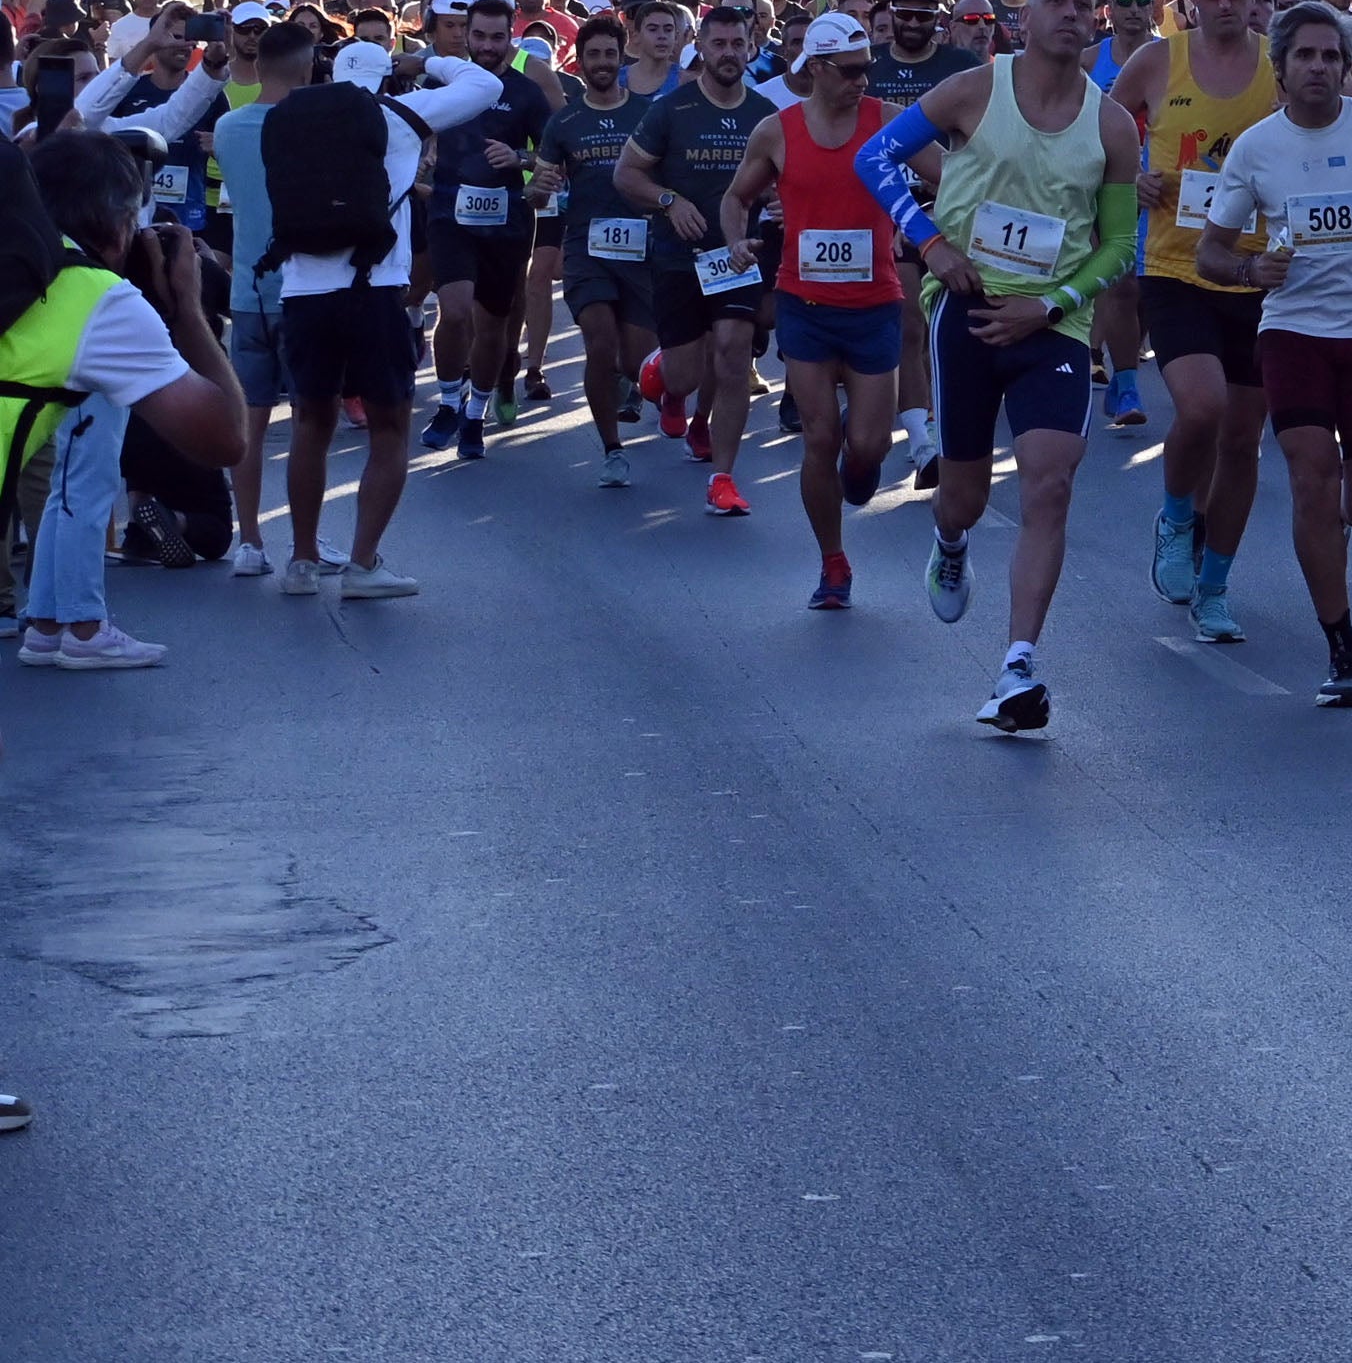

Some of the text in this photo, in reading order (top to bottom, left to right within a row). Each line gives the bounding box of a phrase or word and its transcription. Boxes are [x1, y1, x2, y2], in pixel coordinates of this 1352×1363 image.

[1169, 95, 1192, 107] vive
[686, 148, 743, 161] MARBE
[465, 196, 500, 211] 3005
[1308, 205, 1352, 232] 508
[603, 226, 630, 245] 181
[1002, 221, 1029, 250] 11
[815, 242, 852, 263] 208
